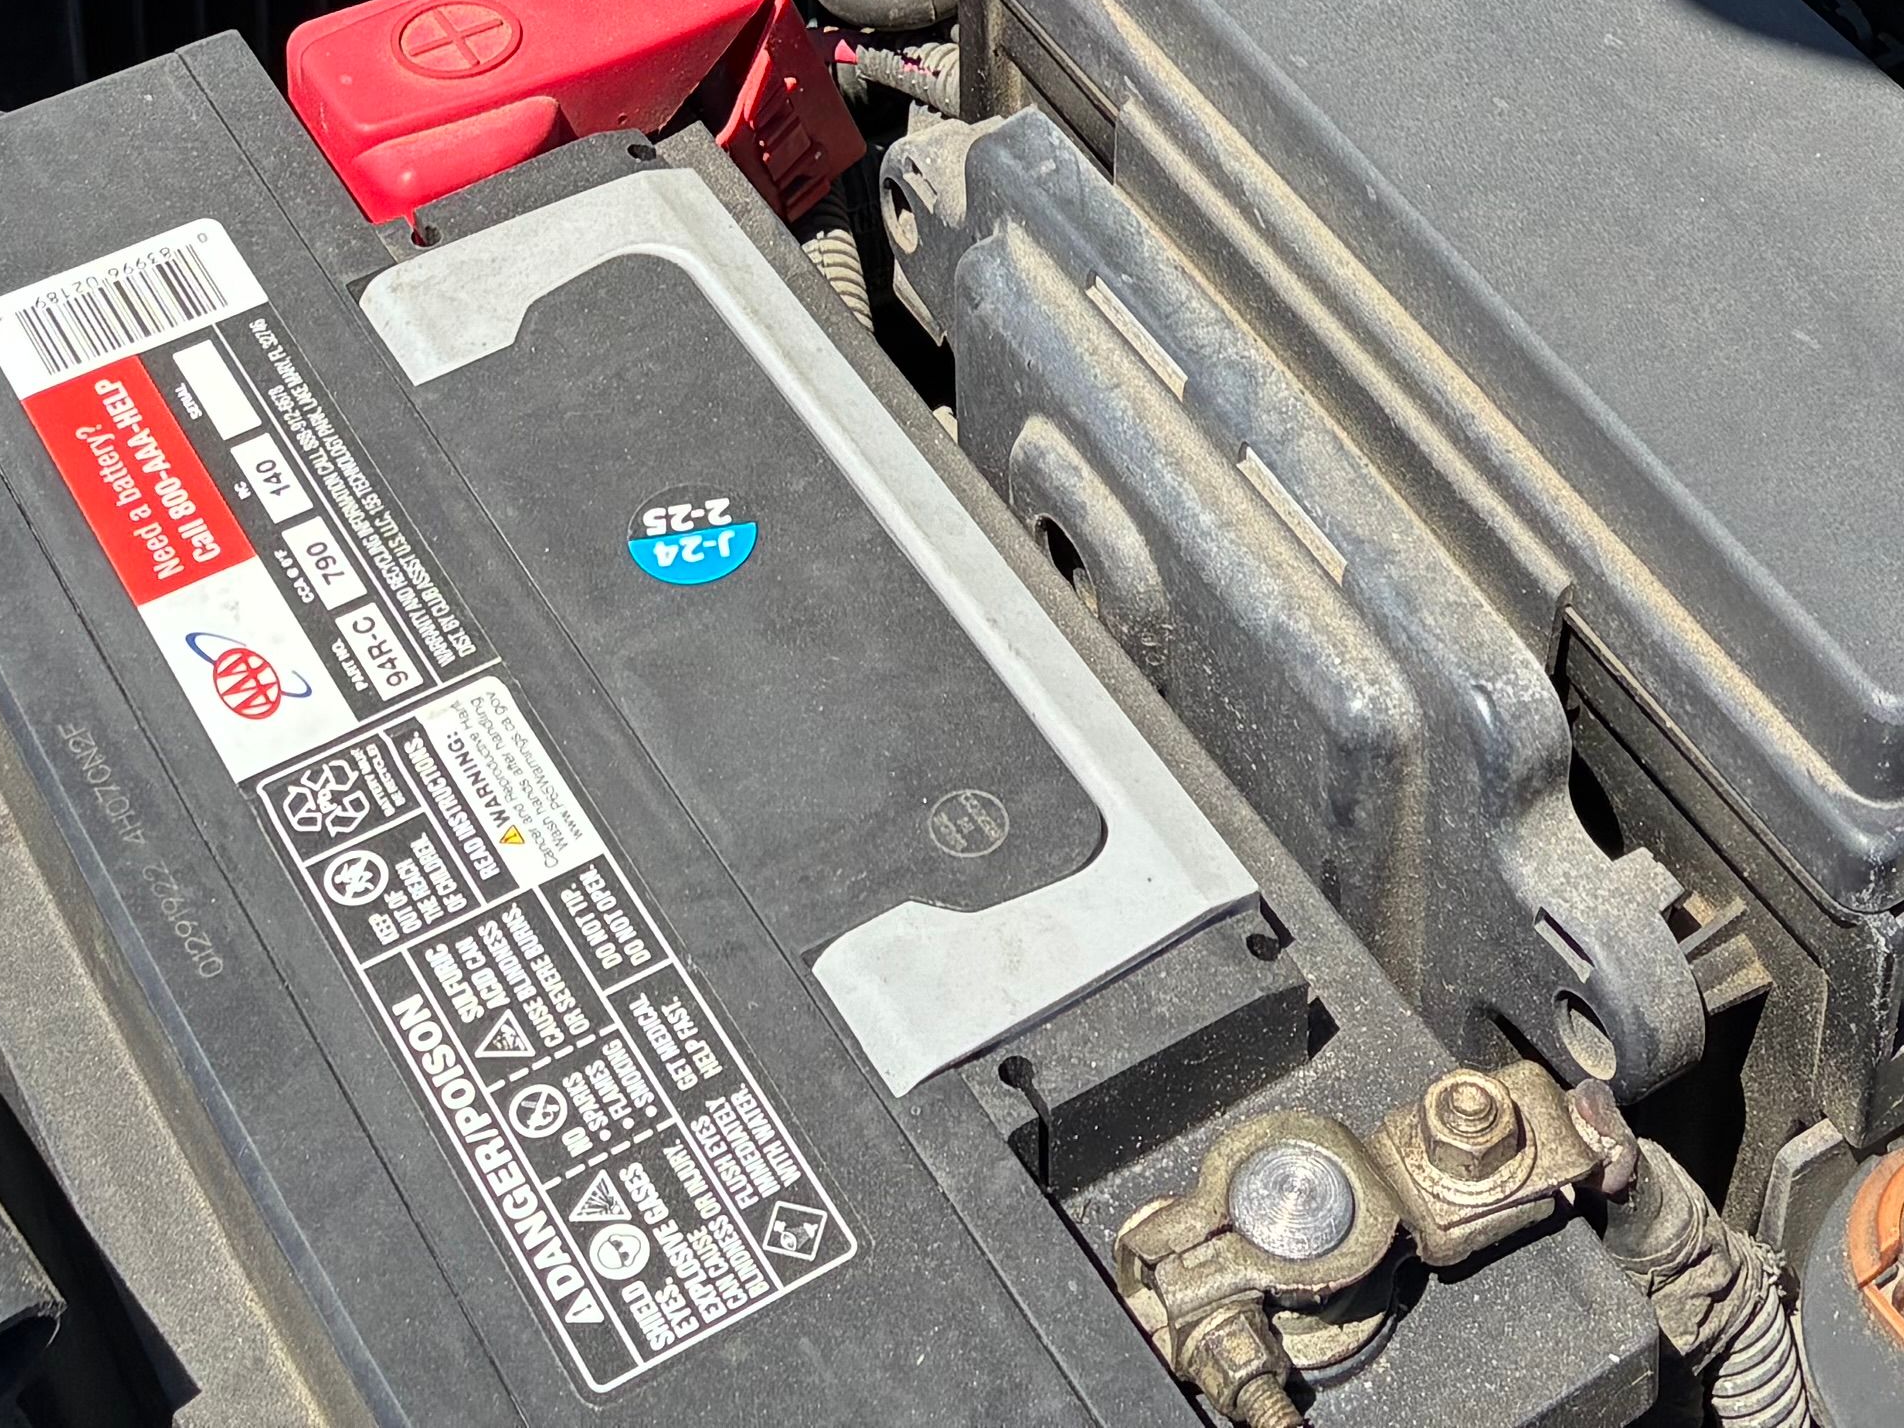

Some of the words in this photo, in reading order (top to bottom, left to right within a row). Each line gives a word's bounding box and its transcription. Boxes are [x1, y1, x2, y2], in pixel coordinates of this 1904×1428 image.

[248, 317, 278, 349] 32746
[267, 344, 286, 361] FL
[174, 382, 202, 419] SERIAL
[289, 382, 318, 411] LAKE
[75, 424, 141, 506] battery?
[95, 379, 195, 519] 800-AAA-HELP
[308, 446, 334, 475] CALL
[322, 434, 372, 497] TECHNOLOGY
[233, 480, 251, 500] RC
[255, 459, 290, 496] 140
[129, 503, 151, 521] a
[323, 471, 374, 538] INFORMATION
[360, 492, 384, 515] 155
[641, 496, 732, 536] 2-25
[133, 522, 184, 579] Need
[177, 518, 220, 562] Call
[362, 534, 407, 590] RECYCLING
[387, 531, 411, 557] U.S.
[651, 528, 736, 567] J-24
[305, 541, 344, 585] 790
[398, 553, 433, 589] ASSIST
[293, 576, 314, 603] CCA
[395, 586, 422, 611] AND
[421, 586, 450, 617] CLUB
[408, 609, 455, 667] WARRANTY
[437, 613, 460, 632] BY
[351, 616, 408, 686] 94R-C
[213, 647, 281, 719] AAA
[340, 659, 368, 691] PART
[469, 695, 504, 750] handling
[403, 731, 475, 840] INSTRUCTIONS.
[446, 731, 510, 827] WARNING:
[469, 731, 516, 802] Reproductive
[501, 752, 523, 775] after
[363, 773, 395, 817] BATTERY
[388, 788, 406, 806] BE
[512, 802, 533, 824] and
[518, 777, 544, 815] hands
[527, 827, 559, 868] Cancer
[541, 815, 568, 851] Wash
[394, 857, 431, 901] REACH
[410, 832, 457, 895] CHILDREN.
[460, 836, 499, 880] READ
[383, 889, 408, 909] OF
[416, 894, 444, 924] THE
[442, 892, 467, 913] OF
[560, 882, 588, 916] TIP.
[579, 863, 616, 911] OPEN.
[367, 913, 399, 945] KEEP
[393, 905, 422, 933] OUT
[501, 902, 544, 959] BURNS.
[574, 912, 608, 946] NOT
[602, 909, 636, 943] NOT
[454, 935, 486, 970] CAN
[477, 920, 536, 1001] BLINDNESS
[594, 941, 622, 969] DO
[623, 938, 651, 966] DO
[424, 943, 484, 1022] SULFURIC
[470, 967, 510, 1009] ACID
[530, 954, 576, 1012] SEVERE
[522, 996, 564, 1047] CAUSE
[562, 1007, 590, 1035] OR
[629, 992, 679, 1061] MEDICAL
[660, 995, 698, 1040] FAST.
[602, 1038, 654, 1108] SMOKING
[665, 1057, 698, 1091] GET
[684, 1039, 722, 1079] HELP
[562, 1071, 608, 1131] SPARKS
[584, 1059, 631, 1120] FLAMES
[730, 1082, 775, 1145] WATER.
[393, 995, 583, 1298] DANGER/POISON
[561, 1126, 593, 1157] NO
[690, 1114, 727, 1158] EYES
[705, 1096, 780, 1197] IMMEDIATELY
[662, 1138, 708, 1197] INJURY.
[713, 1153, 758, 1209] FLUSH
[762, 1139, 801, 1187] WITH
[618, 1162, 668, 1224] GASES
[693, 1191, 721, 1219] OR
[652, 1219, 726, 1322] EXPLOSIVE
[686, 1225, 729, 1278] CAUSE
[707, 1214, 769, 1298] BLINDNESS
[654, 1276, 699, 1338] EYES.
[714, 1273, 747, 1309] CAN
[621, 1280, 674, 1350] SHIELD
